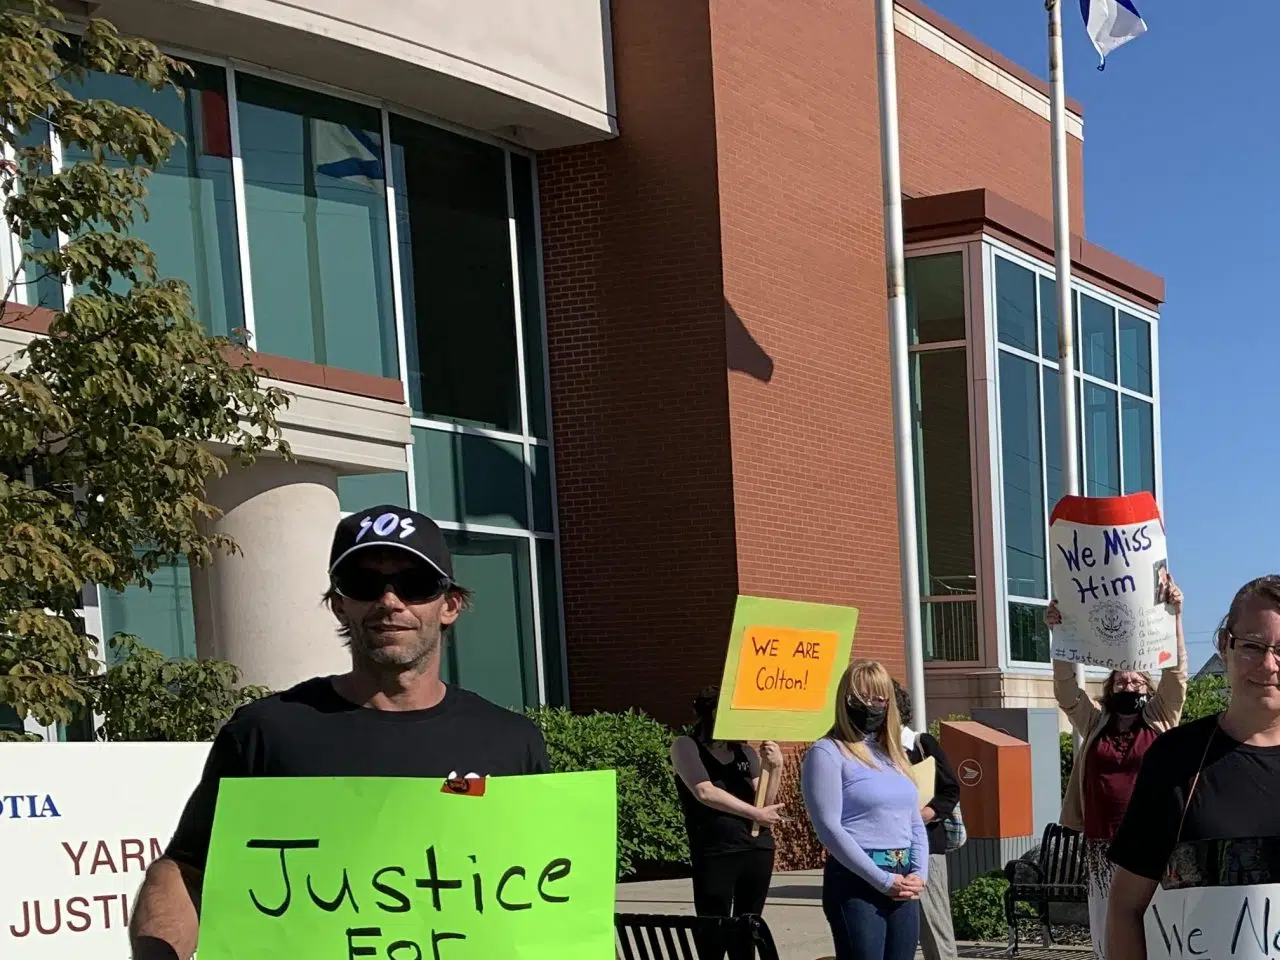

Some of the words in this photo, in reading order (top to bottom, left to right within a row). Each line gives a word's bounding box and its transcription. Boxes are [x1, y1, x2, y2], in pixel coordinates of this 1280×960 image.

[355, 512, 416, 543] SOS
[1056, 529, 1096, 572] We
[1103, 525, 1153, 567] Miss
[1071, 575, 1136, 604] Him
[751, 636, 779, 657] WE
[792, 641, 820, 659] ARE
[756, 666, 808, 691] Colton!
[0, 794, 61, 819] TIA
[246, 838, 572, 918] Justice
[1152, 898, 1208, 957] We
